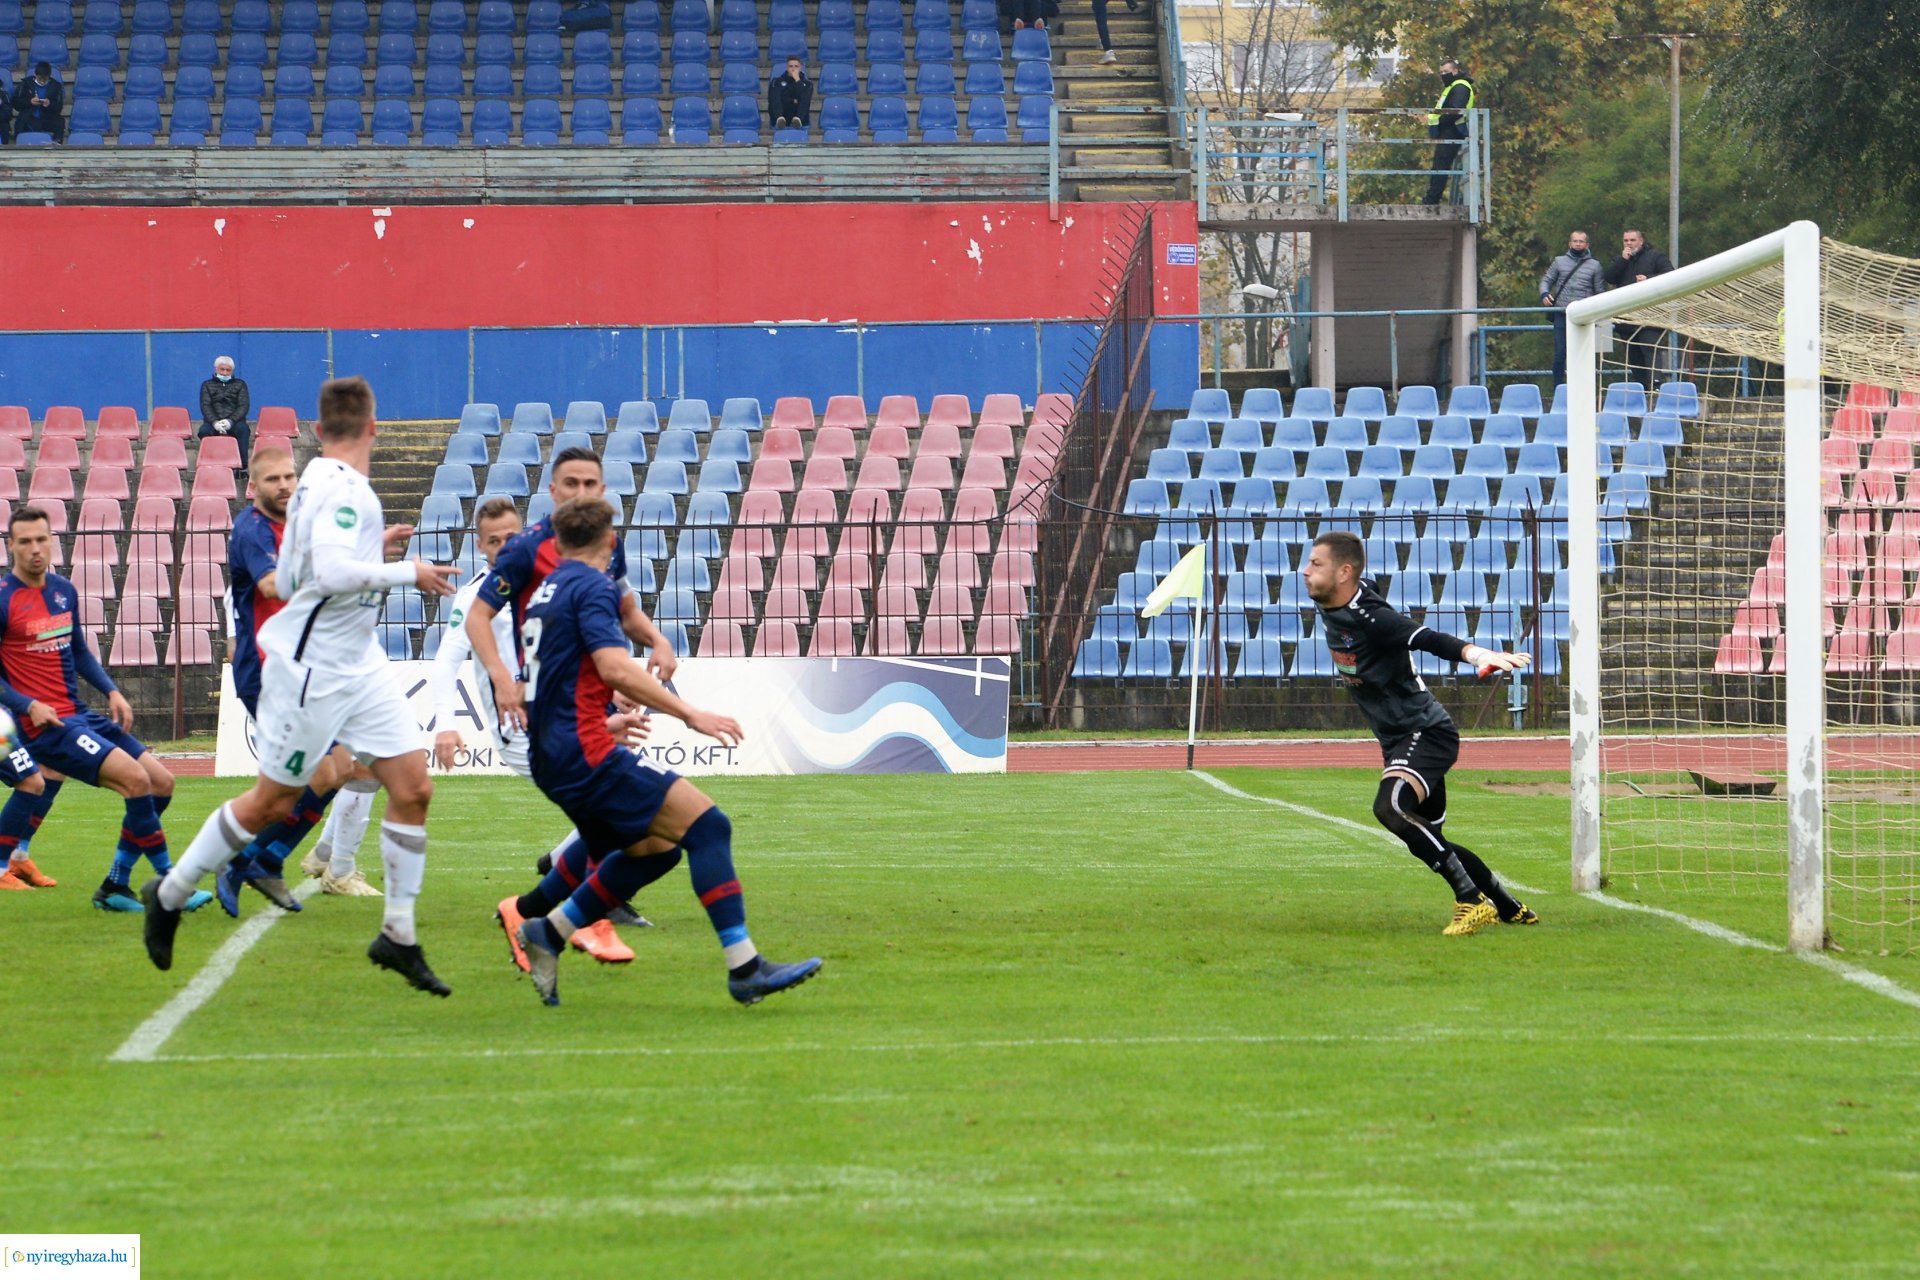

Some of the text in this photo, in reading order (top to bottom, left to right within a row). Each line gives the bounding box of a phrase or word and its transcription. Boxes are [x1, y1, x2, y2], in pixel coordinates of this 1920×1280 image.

[76, 734, 101, 755] 8
[693, 745, 739, 766] KFT.
[8, 747, 34, 773] 22
[285, 750, 306, 777] 4
